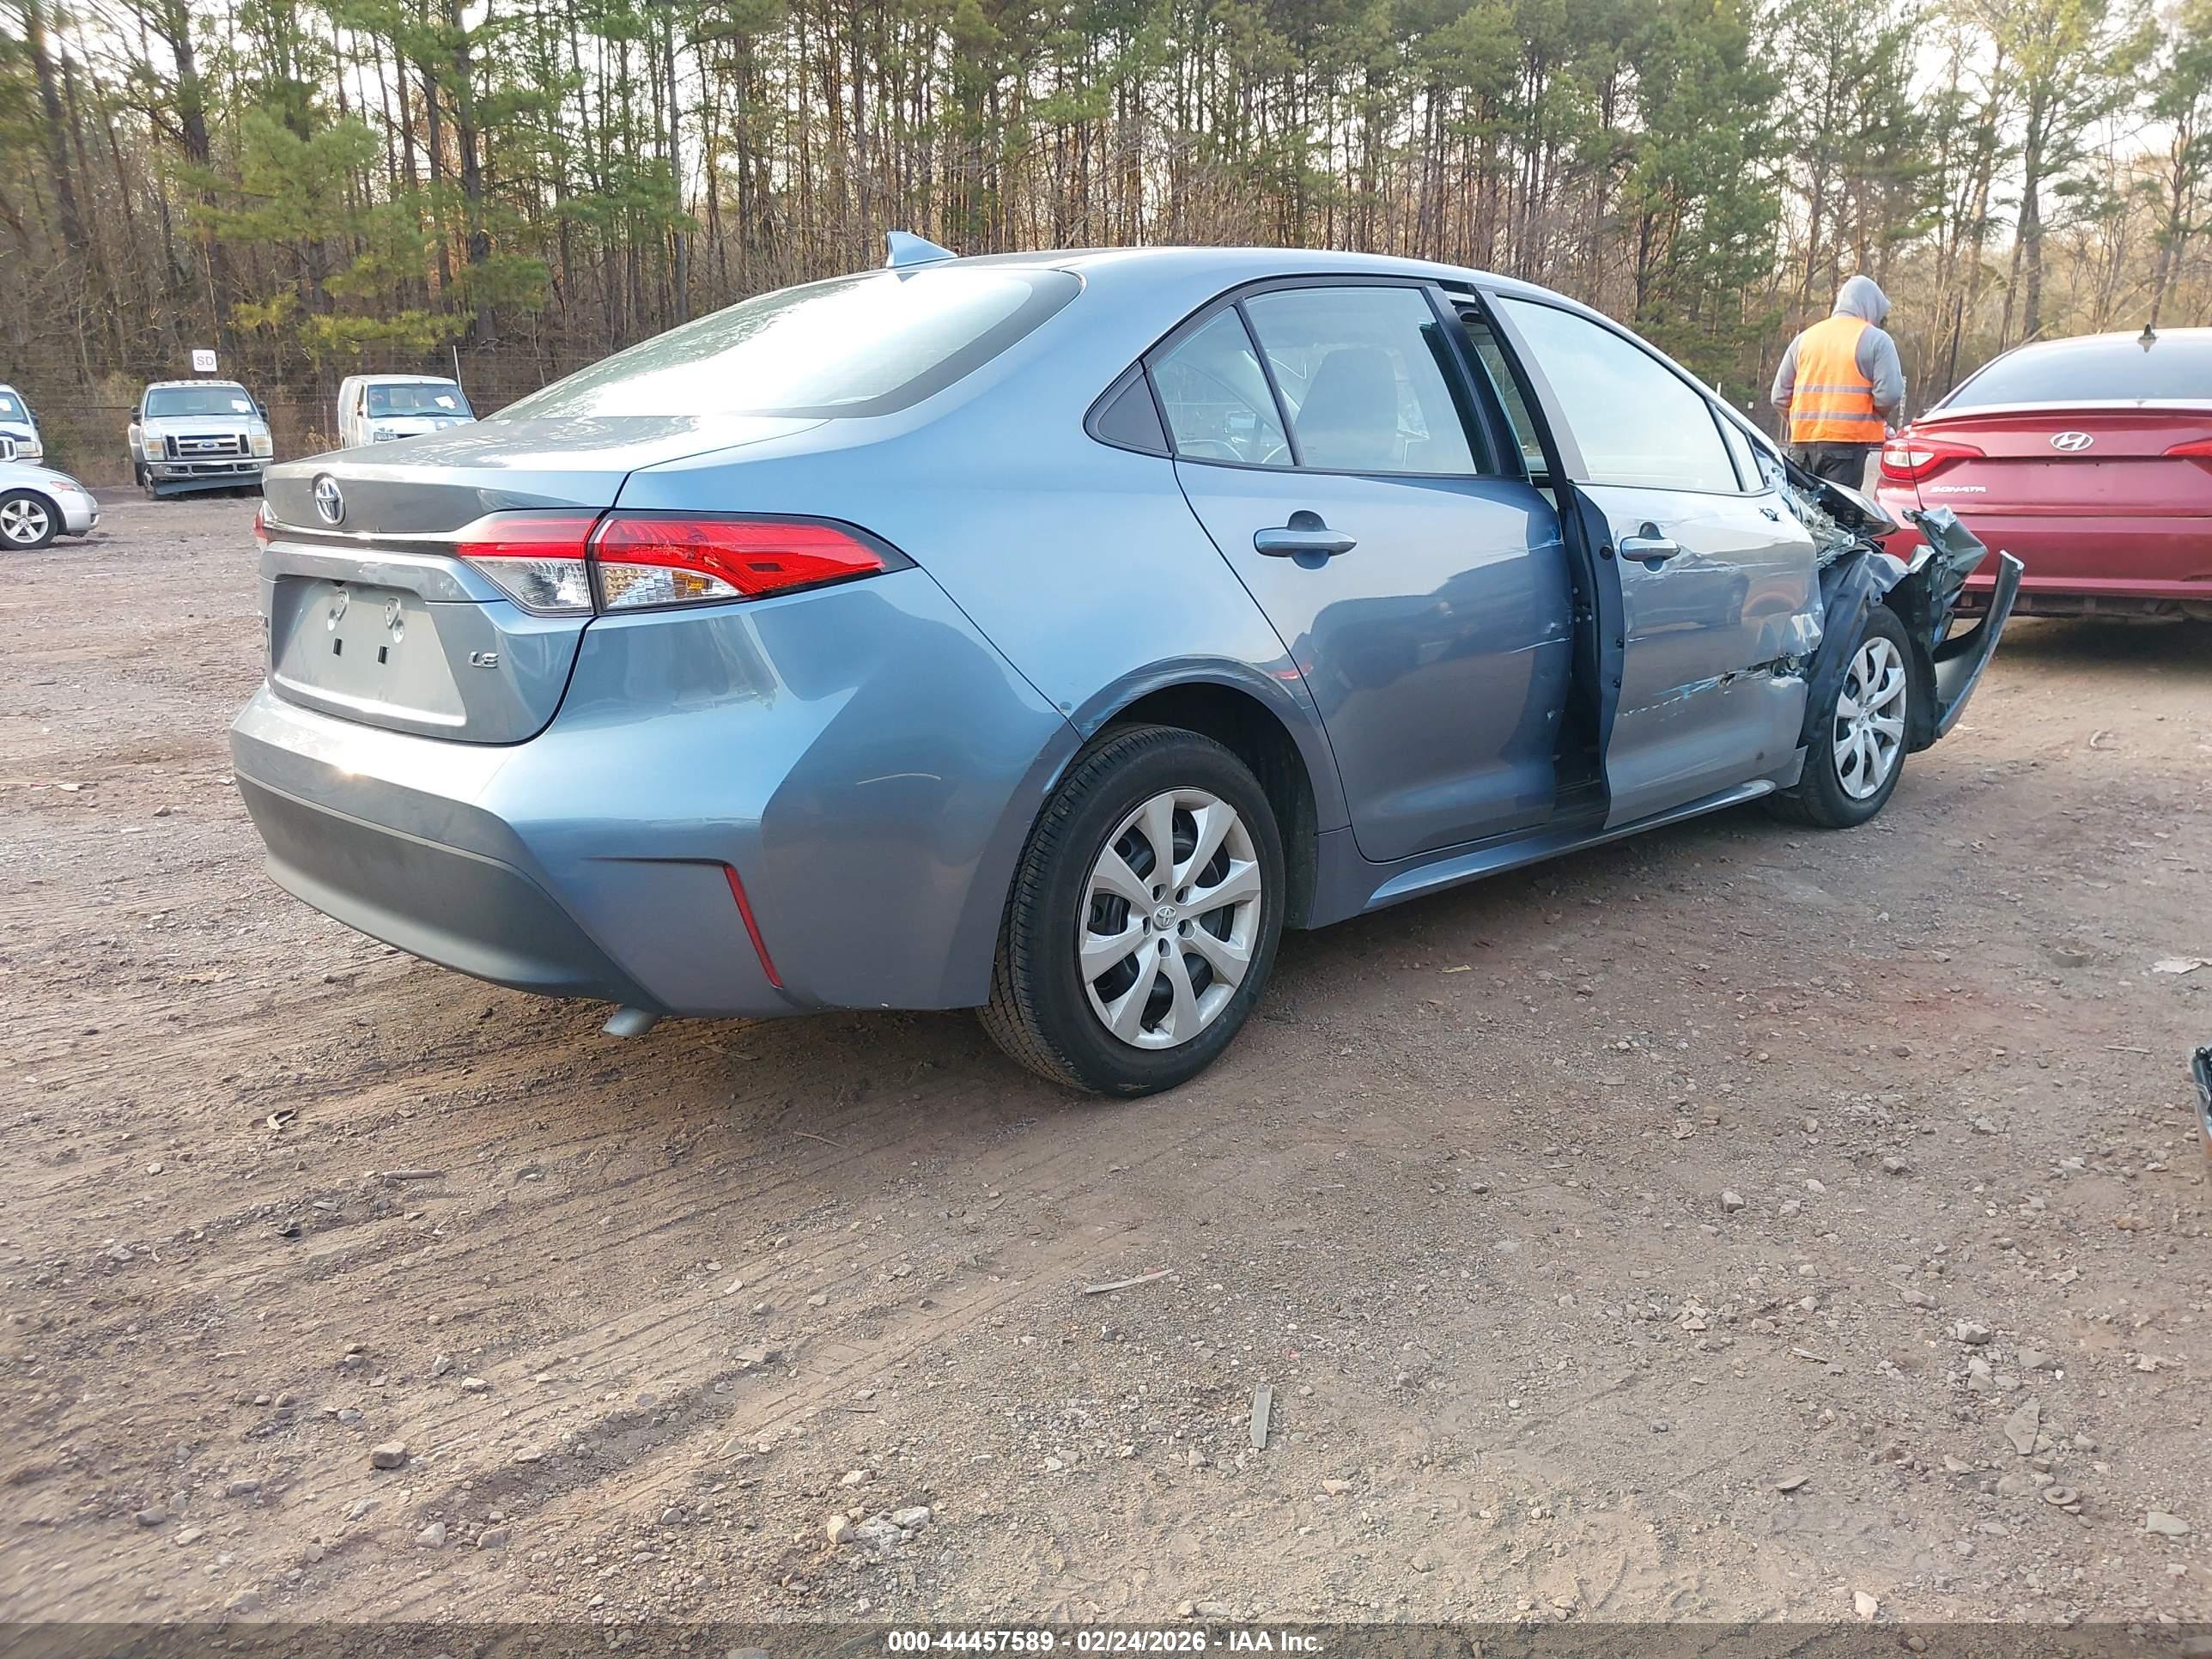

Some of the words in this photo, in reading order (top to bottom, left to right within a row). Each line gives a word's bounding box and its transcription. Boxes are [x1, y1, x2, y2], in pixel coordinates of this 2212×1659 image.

[197, 356, 214, 366] SD
[1929, 485, 1986, 494] SONATA
[468, 651, 498, 669] LE
